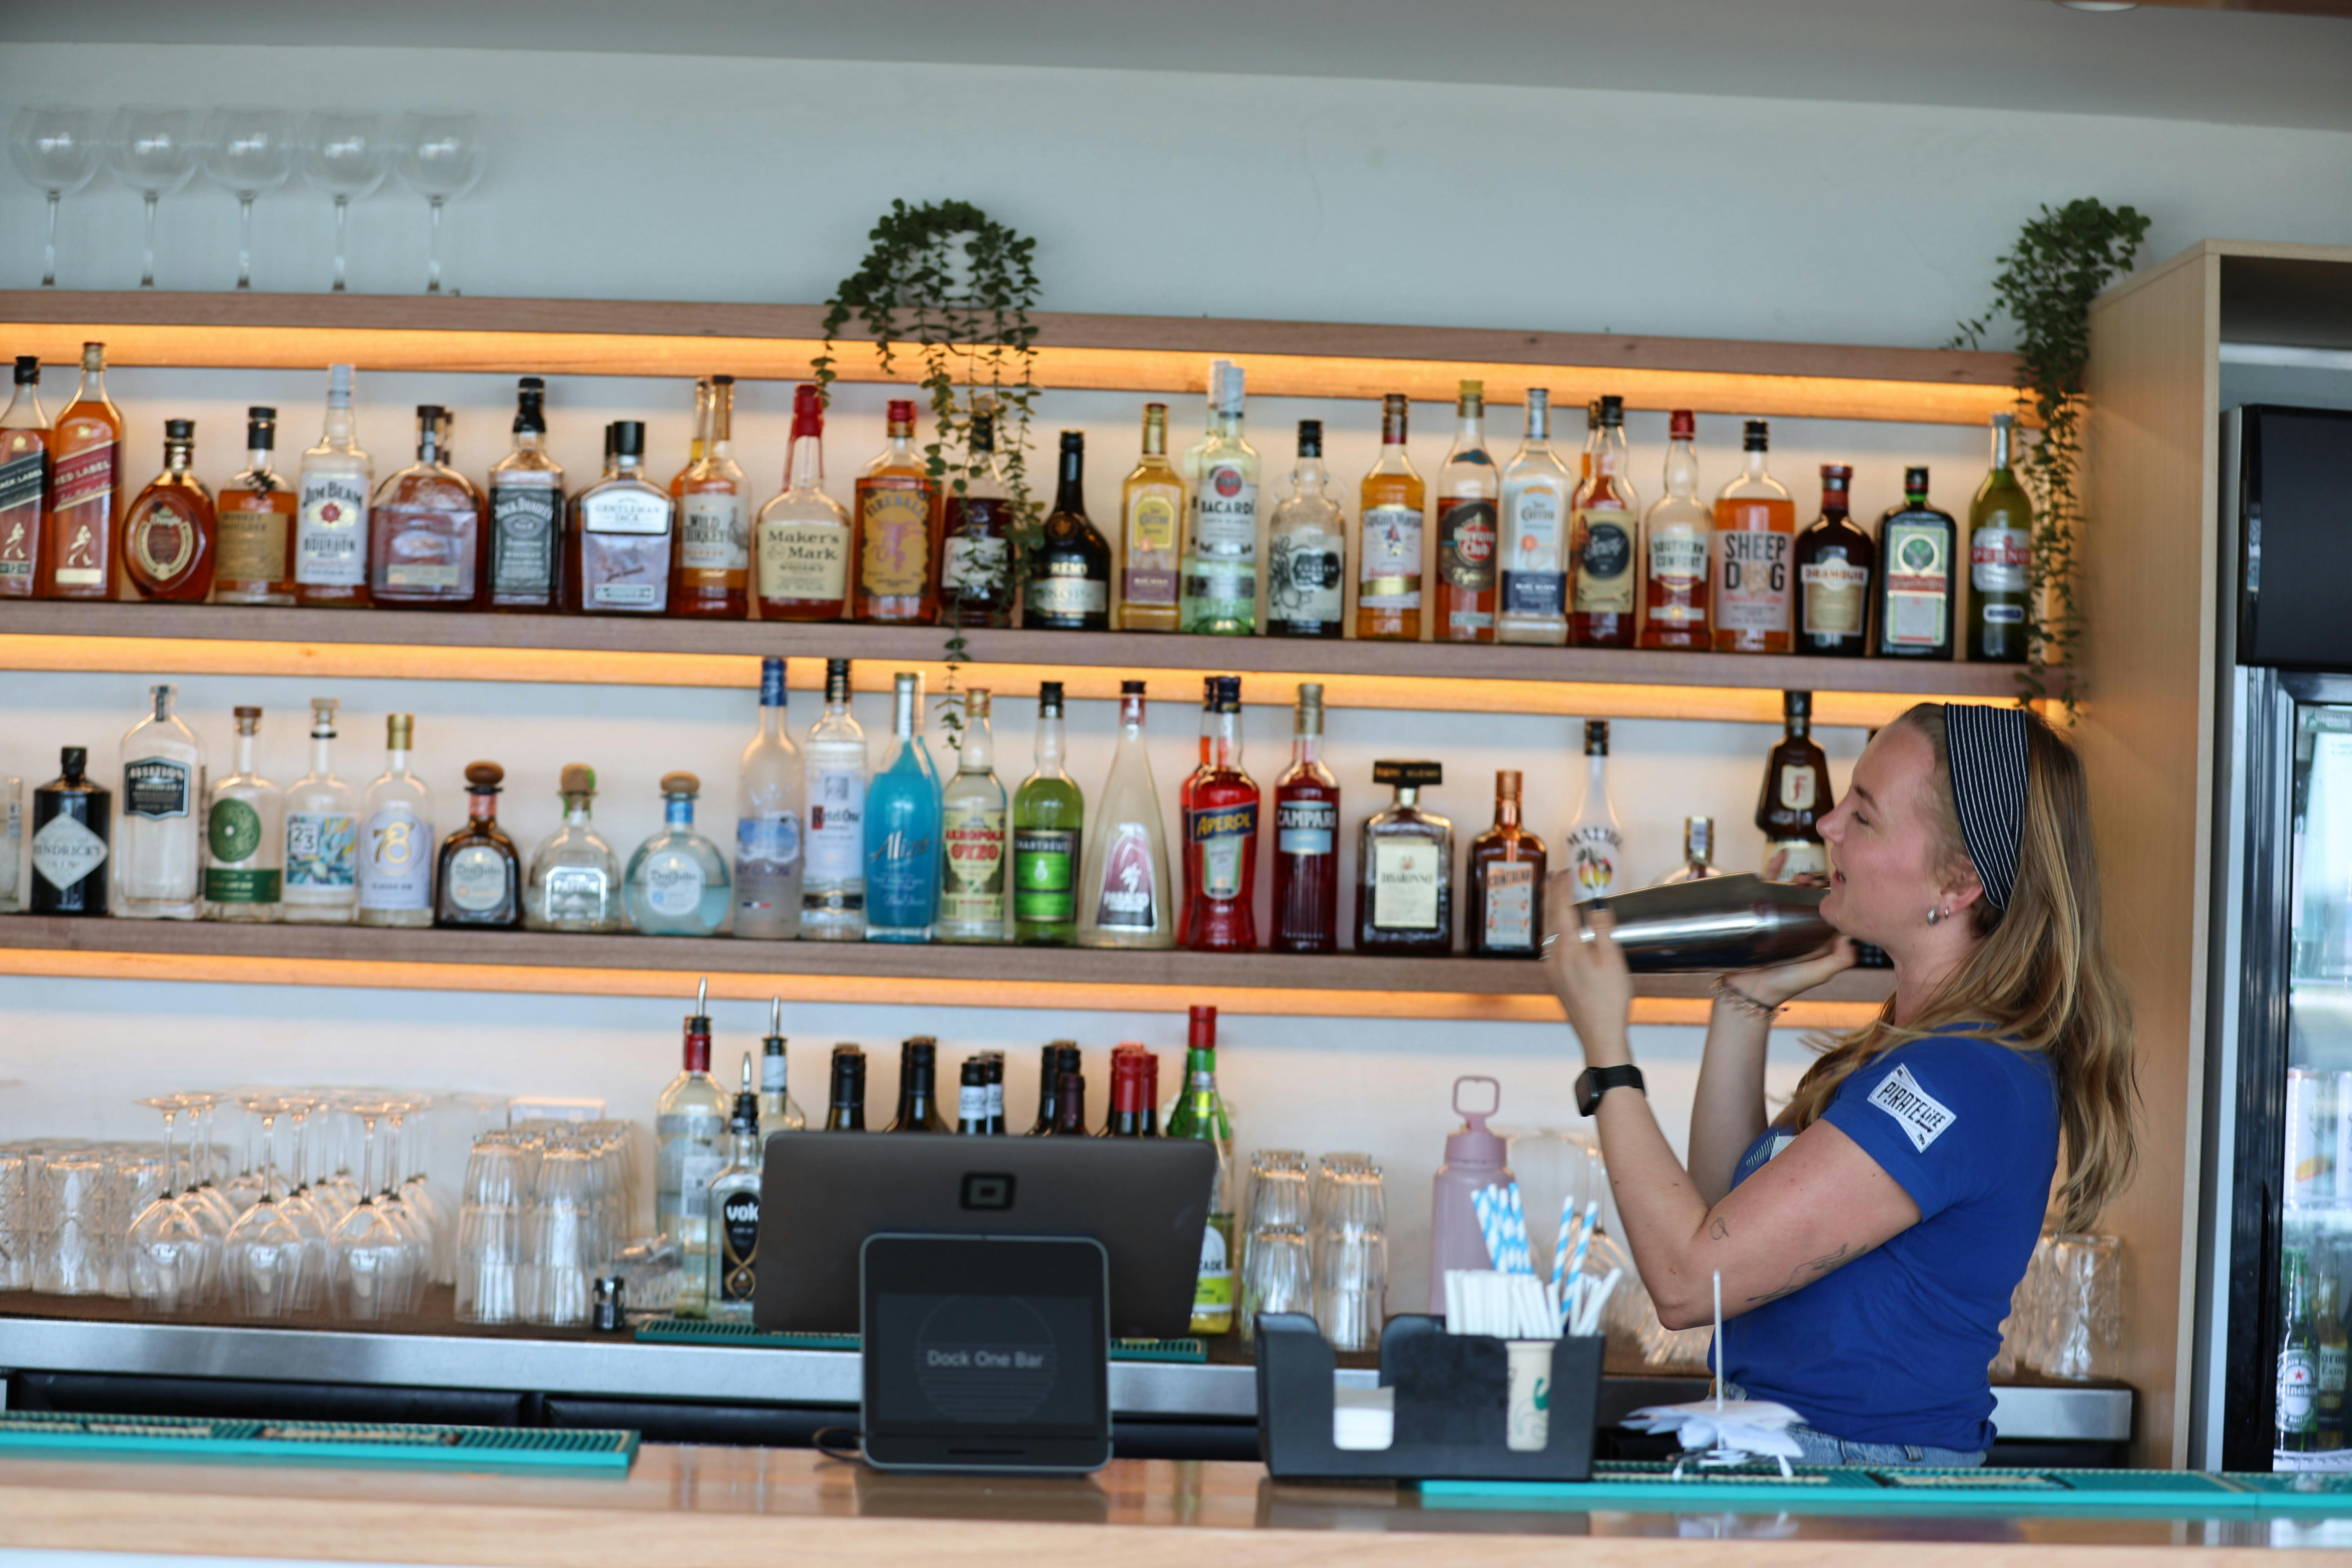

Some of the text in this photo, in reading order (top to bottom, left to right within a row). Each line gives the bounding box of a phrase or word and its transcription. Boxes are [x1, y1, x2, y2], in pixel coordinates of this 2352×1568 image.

[16, 468, 42, 482] LABEL
[54, 472, 74, 485] RED
[75, 460, 111, 477] LABEL
[302, 481, 362, 508] JIM BEAM
[494, 501, 517, 520] JACK
[595, 504, 660, 513] GENTLEMAN
[866, 495, 926, 518] FIREBALL
[1521, 506, 1555, 522] Cuervo
[690, 515, 720, 527] WILD
[1396, 512, 1422, 528] Morga
[685, 526, 726, 543] TURKEY
[768, 530, 839, 544] Maker's
[789, 546, 838, 560] Mark
[1463, 540, 1490, 556] Club
[1653, 541, 1704, 553] SOUTHERN
[1726, 534, 1785, 560] SHEEP
[1655, 554, 1701, 568] COMFORT
[1806, 567, 1864, 579] DRAMBUIE
[842, 809, 860, 822] One
[1277, 808, 1336, 829] CAMPARI
[1196, 811, 1251, 838] APEROL
[1566, 826, 1622, 853] MALIBU
[1380, 871, 1433, 886] DISARONNO
[1877, 1081, 1927, 1121] PIRATE
[726, 1202, 759, 1222] vok
[927, 1349, 1044, 1368] Dock One Bar
